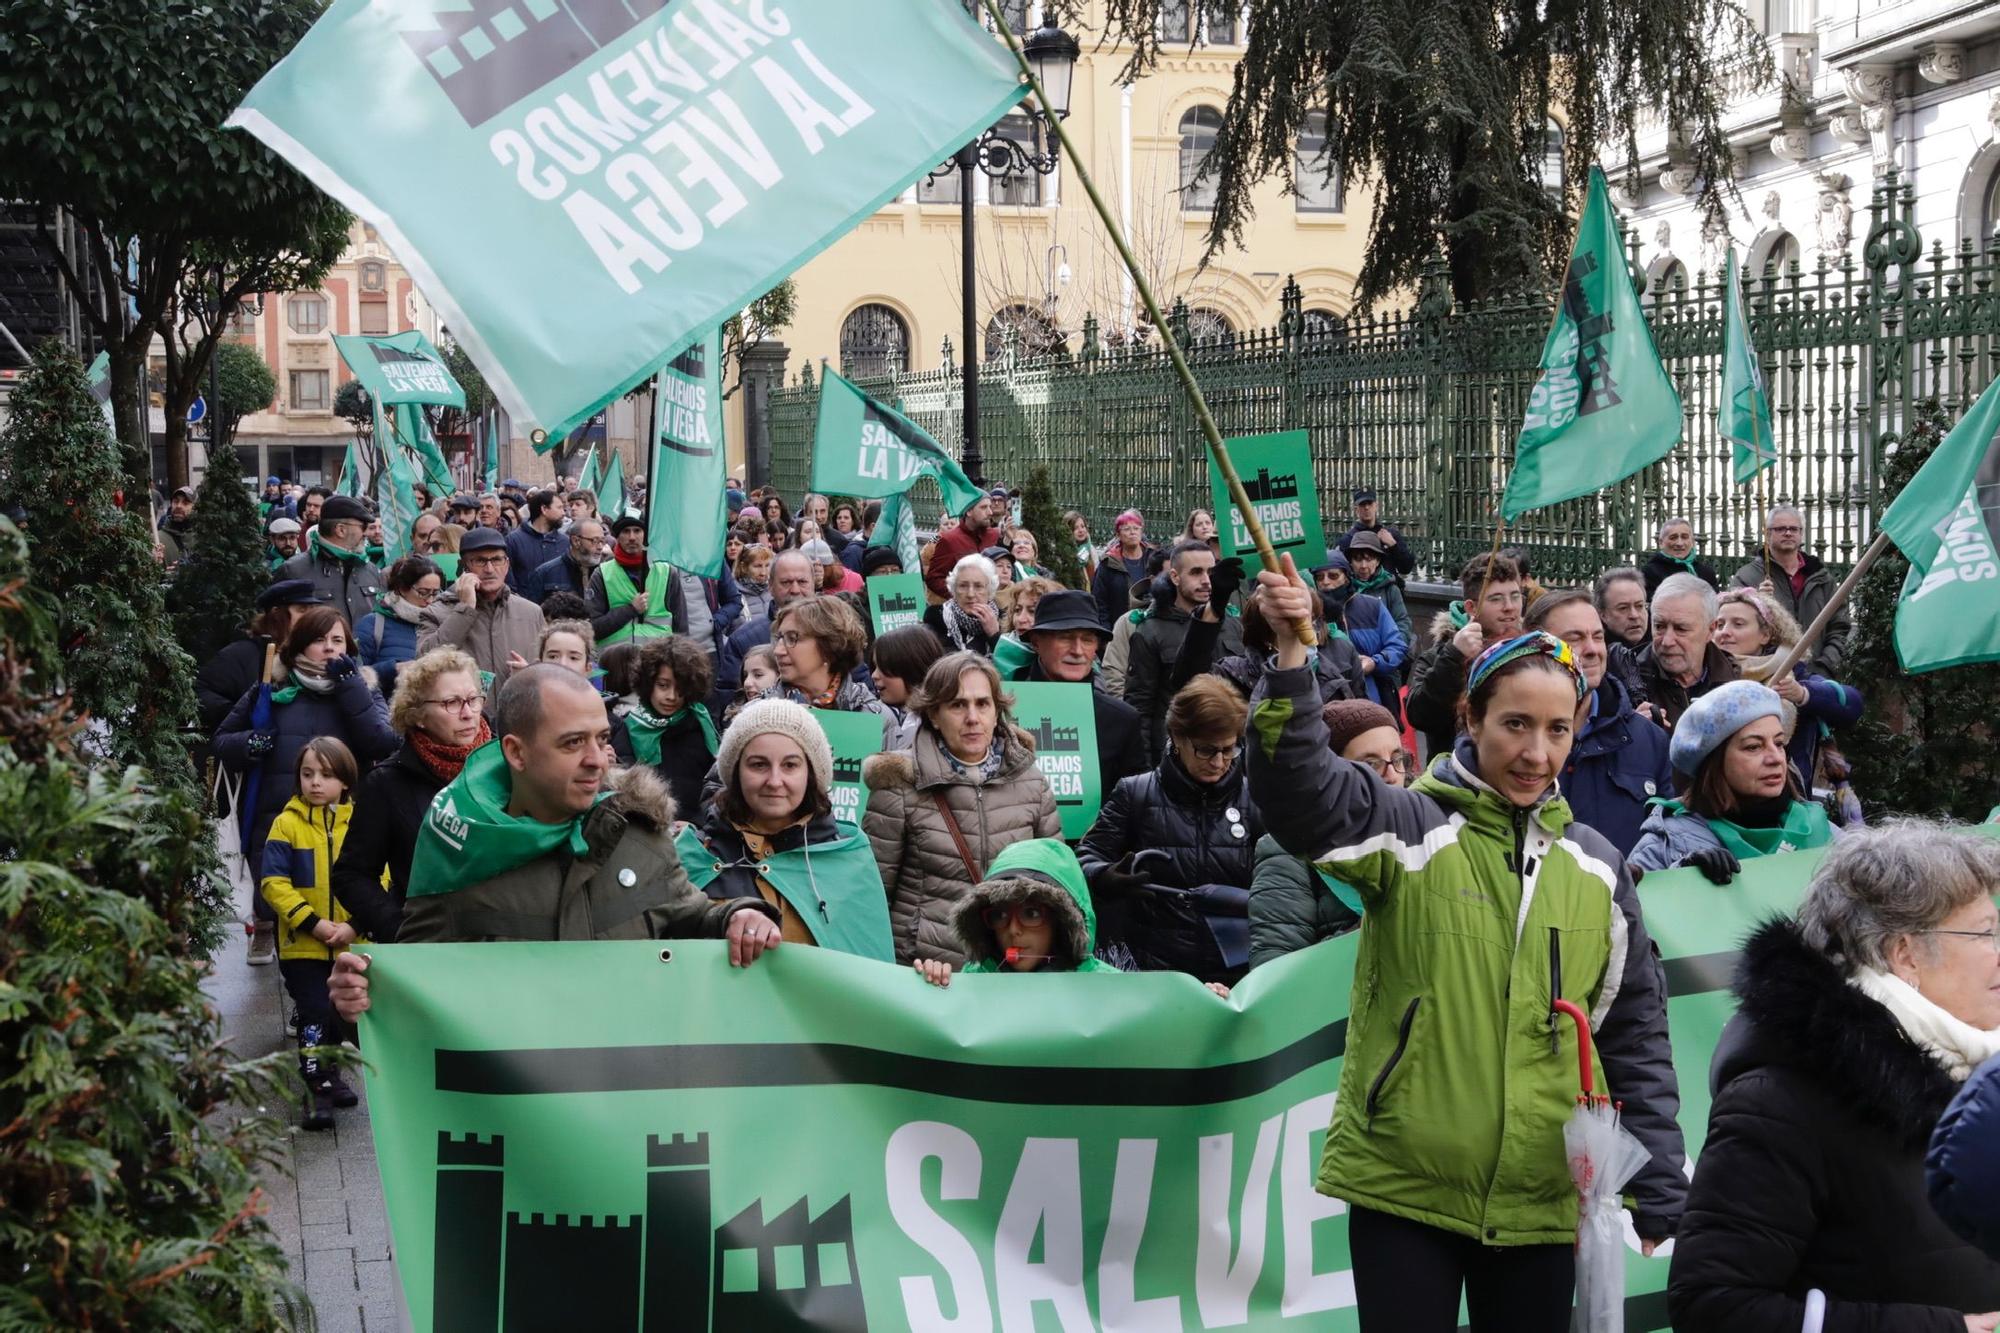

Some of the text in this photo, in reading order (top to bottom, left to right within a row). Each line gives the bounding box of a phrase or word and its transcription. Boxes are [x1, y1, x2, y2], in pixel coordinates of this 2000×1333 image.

[381, 362, 444, 378] SALVEMOS
[388, 377, 452, 394] LA VEGA
[672, 404, 711, 444] VEGA
[857, 446, 888, 480] LA
[1230, 501, 1301, 526] SVEMOS
[1233, 526, 1255, 547] LA
[1036, 755, 1082, 773] VEMOS
[436, 809, 469, 841] VEGA
[884, 1090, 1359, 1333] SALVE
